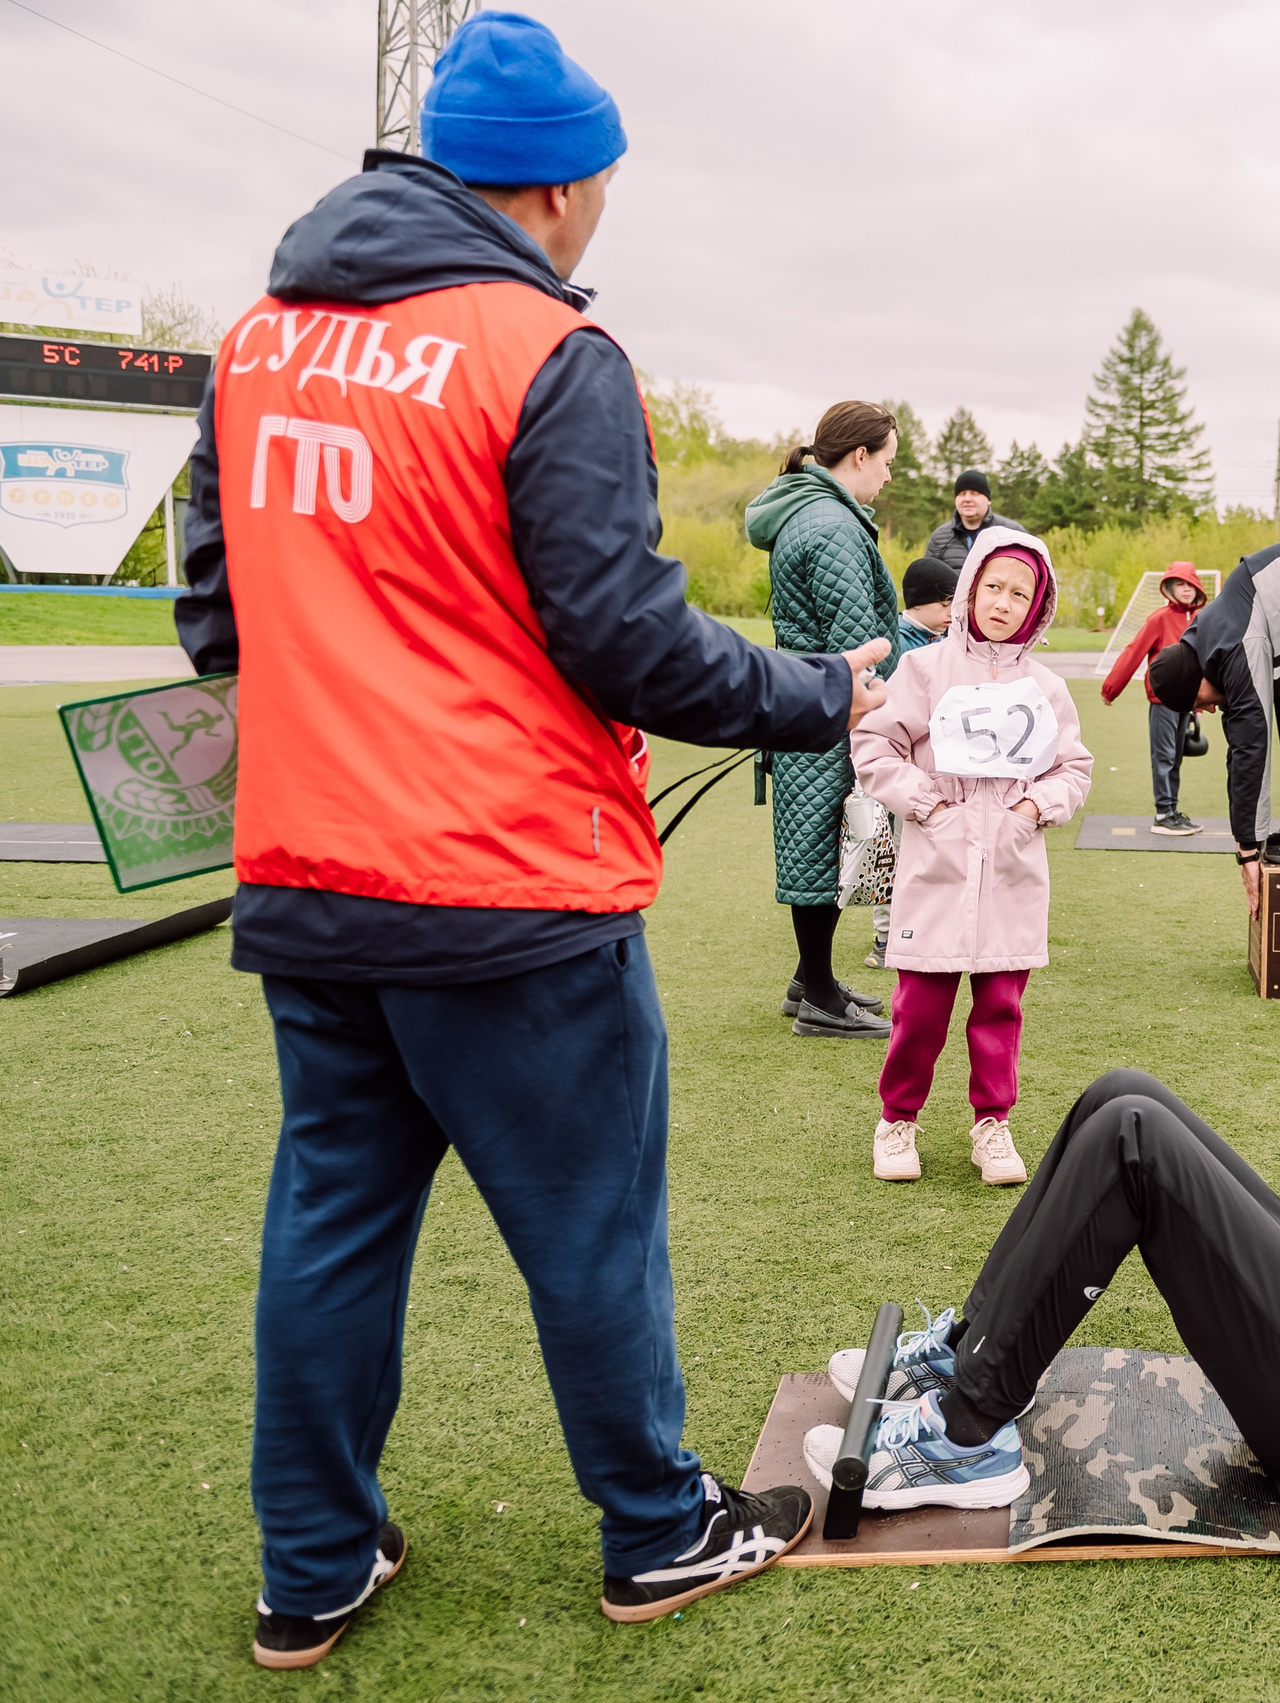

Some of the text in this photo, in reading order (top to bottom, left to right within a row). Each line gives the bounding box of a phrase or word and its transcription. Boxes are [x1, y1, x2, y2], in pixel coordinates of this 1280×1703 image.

[230, 309, 467, 410] СУДЬЯ
[250, 415, 373, 524] ГТО
[119, 727, 166, 778] ГТО
[961, 704, 1034, 764] 52
